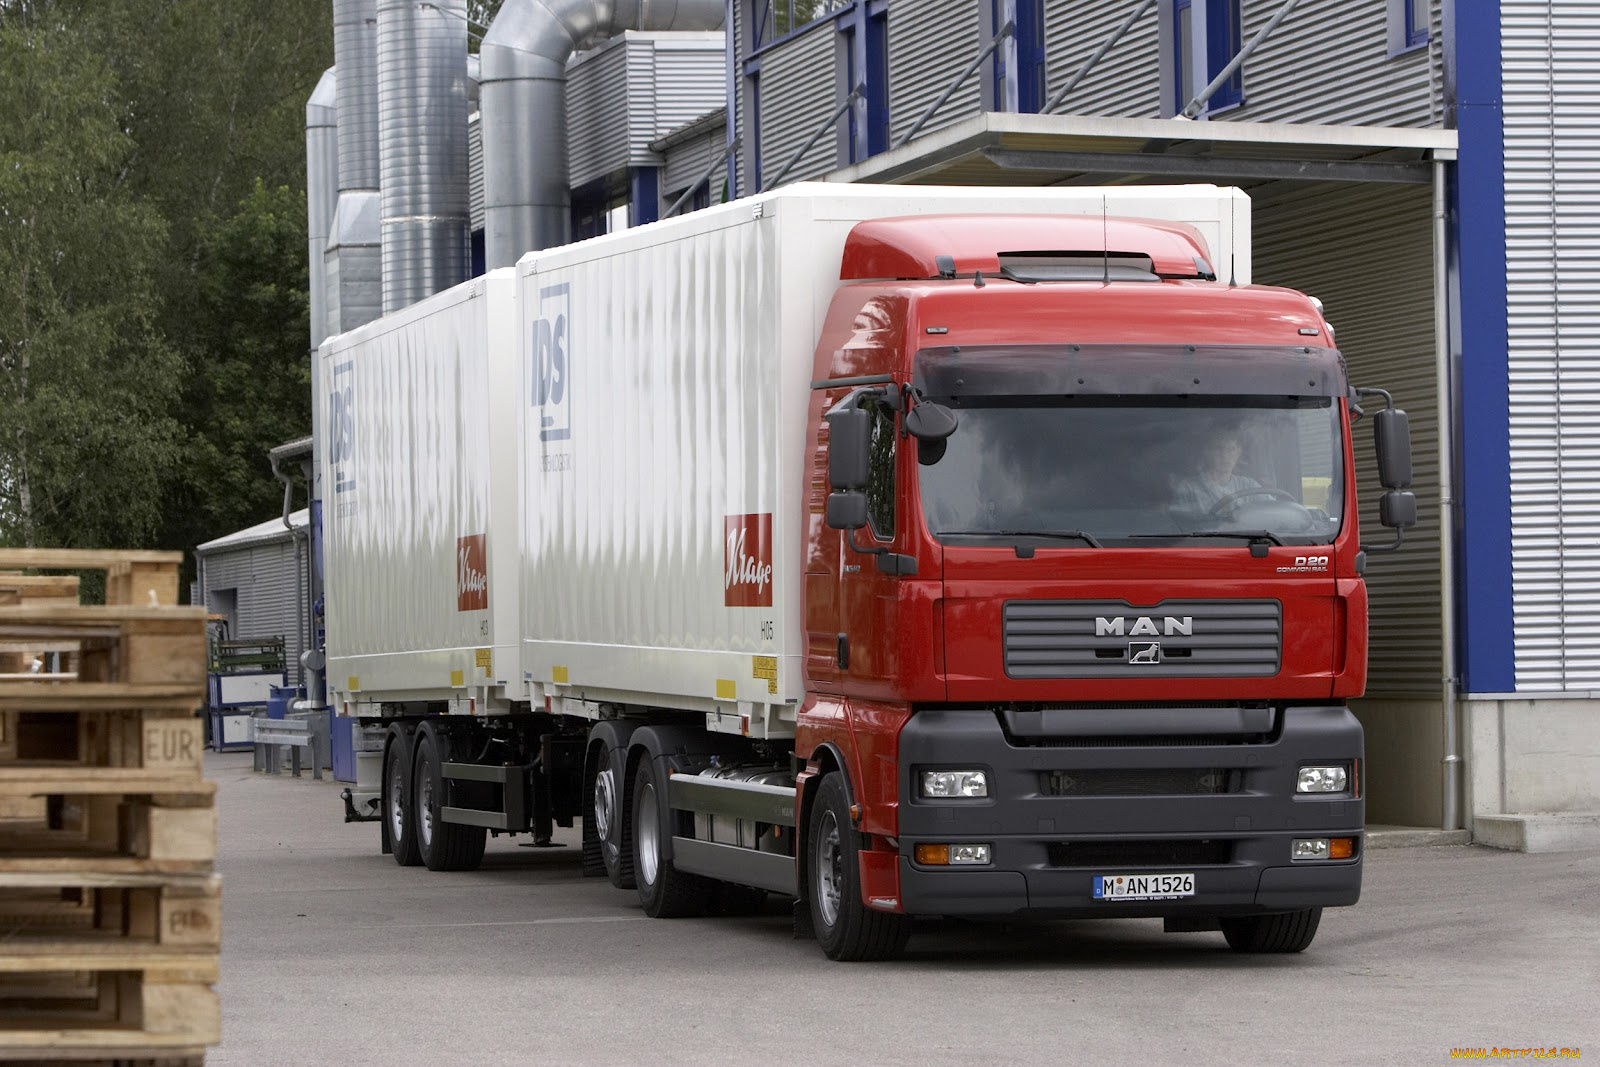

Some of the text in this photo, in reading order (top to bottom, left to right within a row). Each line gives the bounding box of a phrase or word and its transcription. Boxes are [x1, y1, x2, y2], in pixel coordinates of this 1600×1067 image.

[531, 313, 566, 407] IDS
[458, 546, 486, 599] Krage
[726, 527, 771, 594] Krage
[761, 620, 774, 640] H05
[1095, 616, 1193, 636] MAN
[146, 728, 194, 762] EUR
[1103, 879, 1114, 895] M
[1126, 878, 1148, 894] AN
[1151, 876, 1193, 893] 1526
